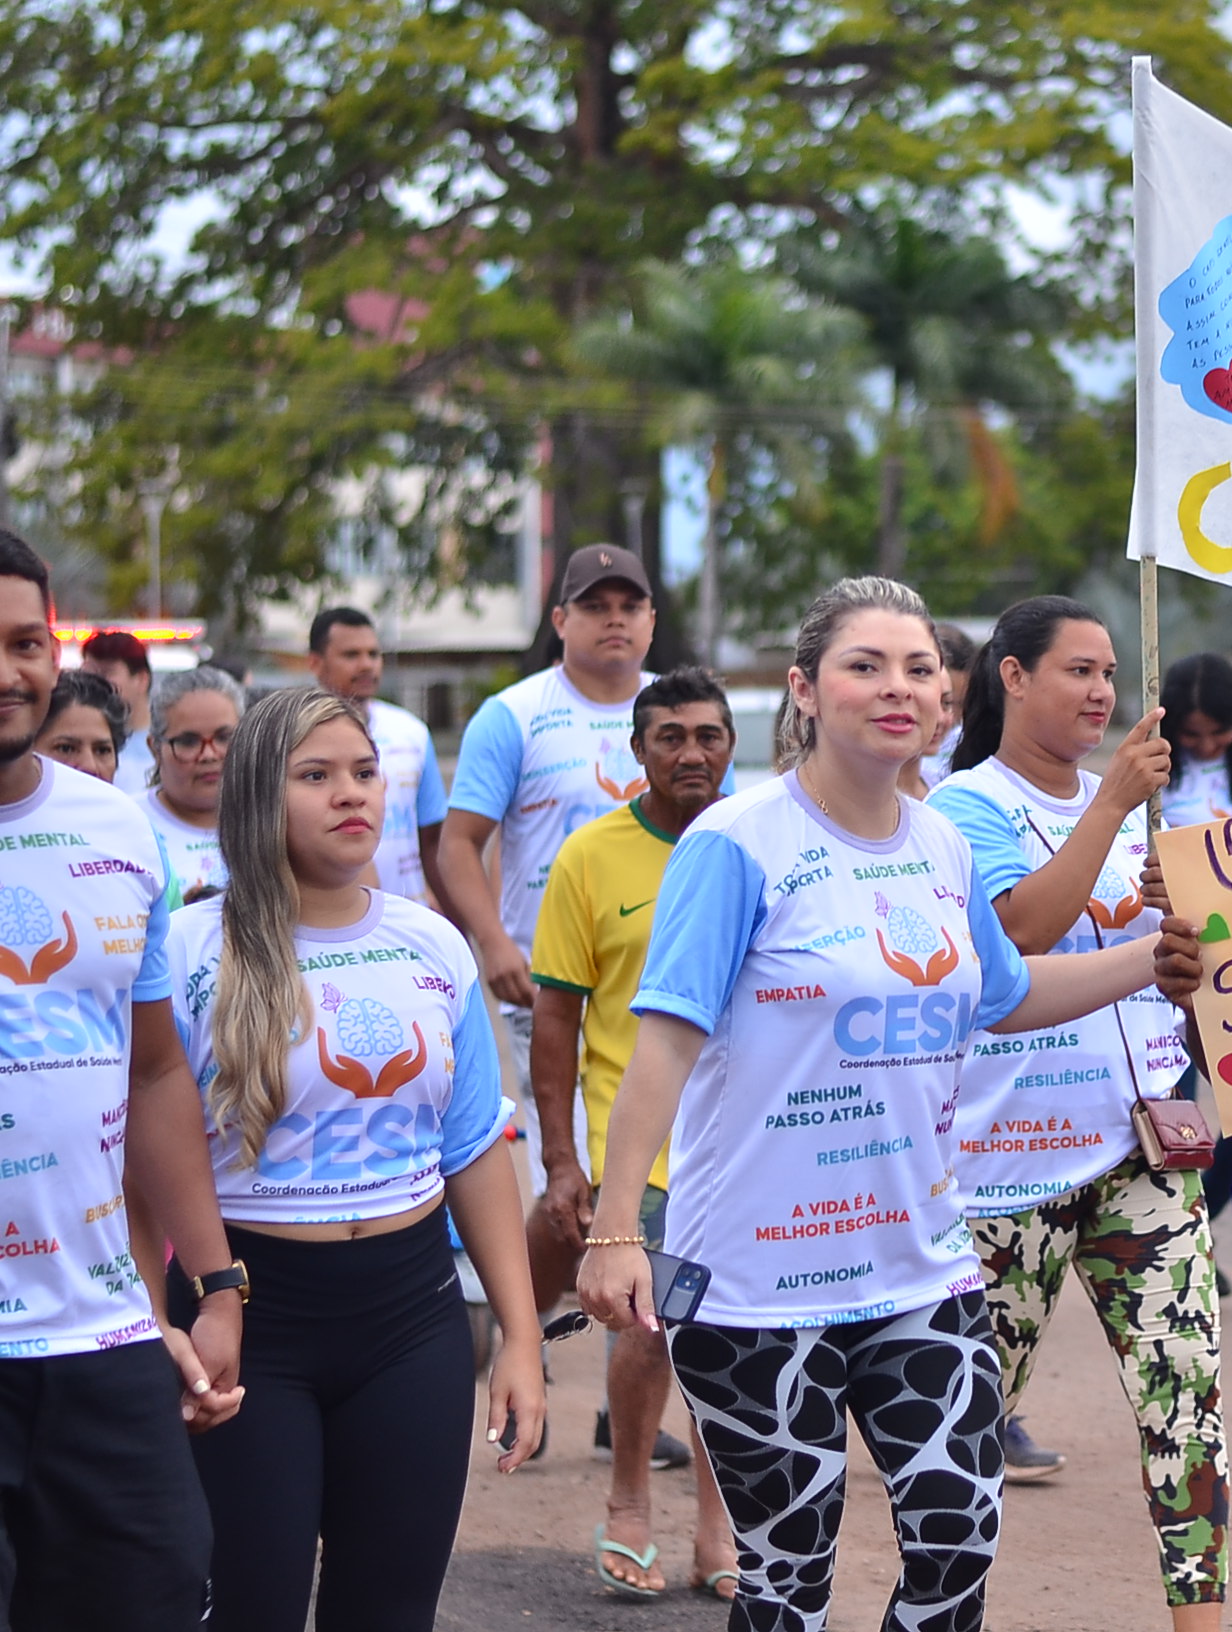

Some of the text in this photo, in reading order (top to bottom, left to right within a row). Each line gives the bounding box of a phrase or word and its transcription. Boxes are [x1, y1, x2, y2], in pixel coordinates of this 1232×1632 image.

[1187, 337, 1209, 350] TEM
[1192, 358, 1206, 368] AS
[19, 833, 90, 849] MENTAL
[853, 862, 897, 880] SAÚDE
[94, 914, 134, 931] FALA
[297, 952, 359, 972] SAÚDE
[755, 984, 826, 1004] EMPATIA
[973, 1031, 1079, 1057] PASSO ATRÁS
[30, 1059, 74, 1071] Estadual
[76, 1058, 88, 1067] de
[839, 1058, 901, 1070] Coordenação
[1014, 1067, 1111, 1090] RESILIÊNCIA
[787, 1084, 862, 1106] NENHUM
[766, 1100, 885, 1129] PASSO ATRÁS
[990, 1115, 1072, 1134] A VIDA É A
[816, 1135, 913, 1166] RESILIÊNCIA
[960, 1132, 1103, 1154] MELHOR ESCOLHA
[975, 1180, 1073, 1198] AUTONOMIA
[792, 1193, 876, 1218] A VIDA É A
[5, 1221, 20, 1237] A
[755, 1222, 830, 1241] MELHOR
[835, 1209, 910, 1234] ESCOLHA
[776, 1260, 874, 1290] AUTONOMIA
